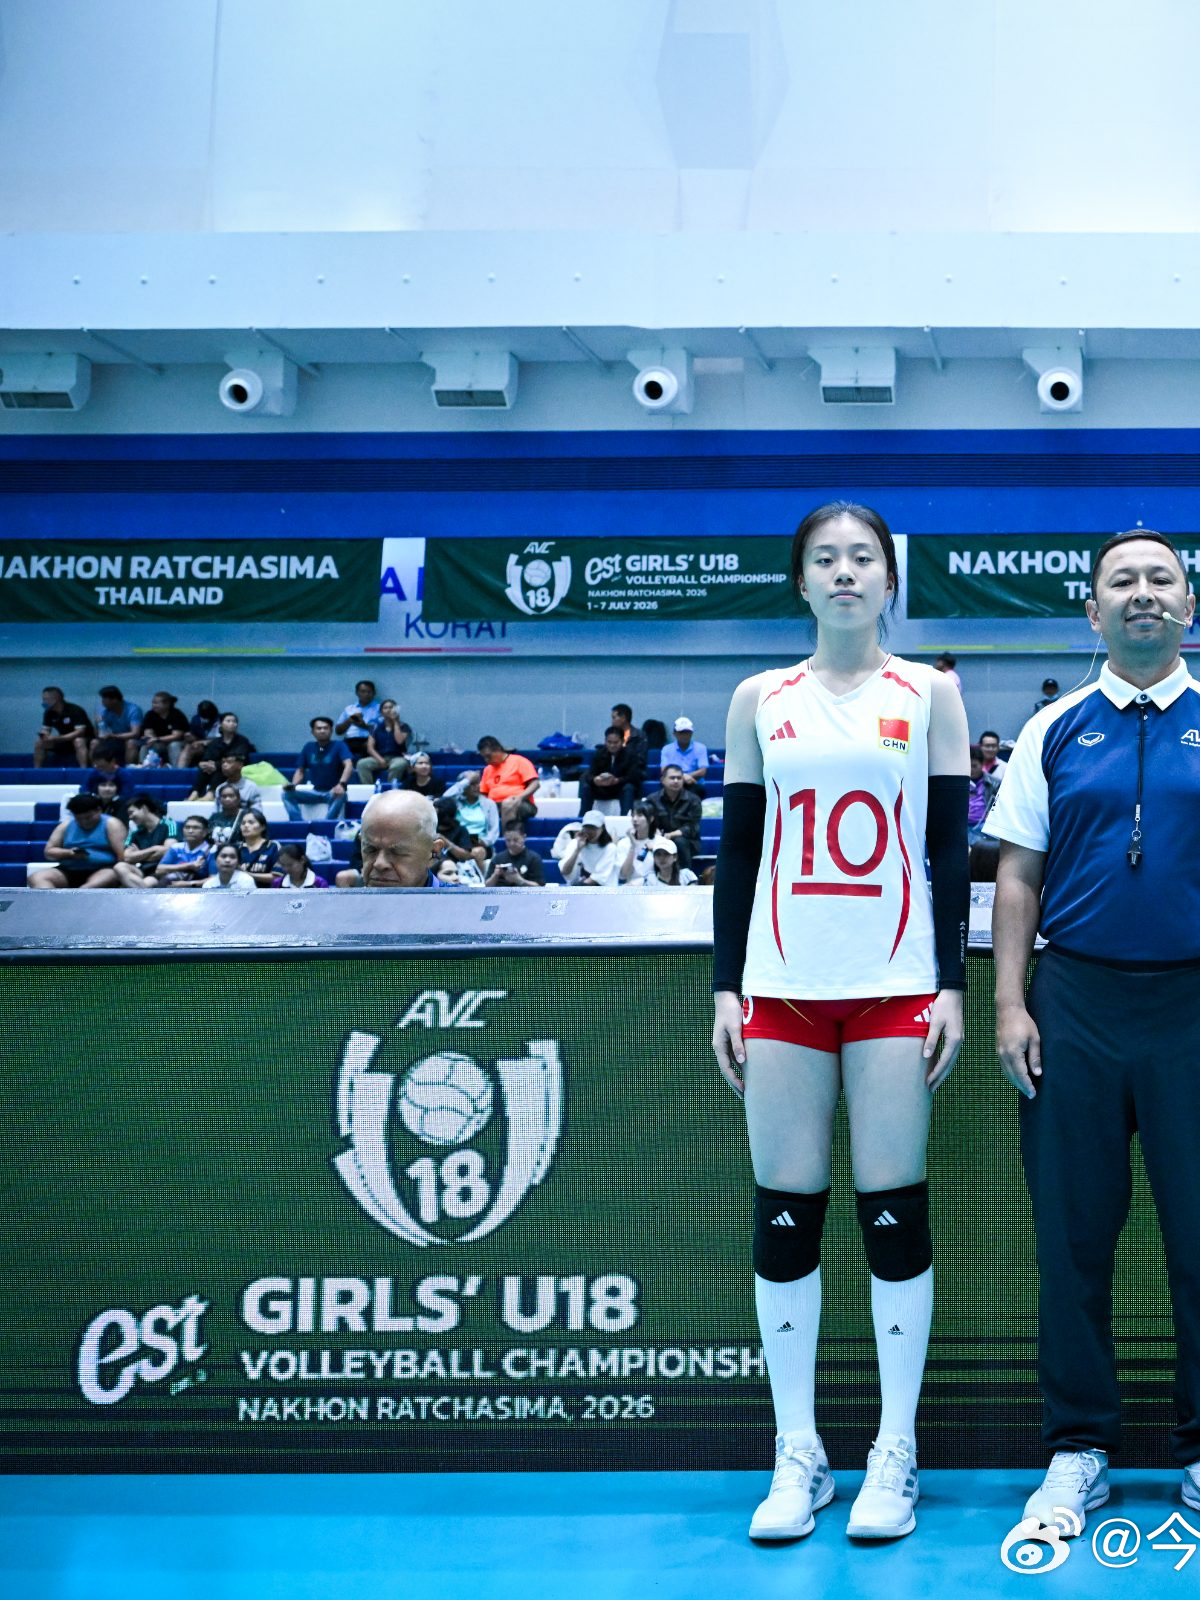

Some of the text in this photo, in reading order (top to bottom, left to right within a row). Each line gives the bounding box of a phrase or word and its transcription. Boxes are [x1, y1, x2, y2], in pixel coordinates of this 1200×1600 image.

[523, 541, 556, 554] AVC
[0, 556, 339, 579] AKHON RATCHASIMA
[585, 554, 622, 585] est
[700, 554, 739, 571] U18
[949, 551, 1091, 574] NAKHON
[626, 575, 698, 585] VOLLEYBALL
[700, 574, 787, 584] CHAMPIONSHIP
[95, 587, 223, 605] THAILAND
[526, 587, 551, 608] 18
[588, 590, 626, 598] NAKHON
[686, 588, 707, 597] 2026
[587, 602, 592, 610] 1
[600, 602, 606, 610] 7
[608, 602, 631, 610] JULY
[633, 601, 658, 610] 2026
[883, 738, 906, 750] CHN
[789, 788, 889, 877] 10
[397, 990, 509, 1028] AVC
[406, 1149, 490, 1223] 18
[504, 1274, 640, 1332] U18
[78, 1295, 208, 1405] est
[241, 1347, 766, 1379] VOLLEYBALL CHAMPIONSH
[238, 1397, 369, 1421] NAKHON
[581, 1395, 655, 1419] 2026
